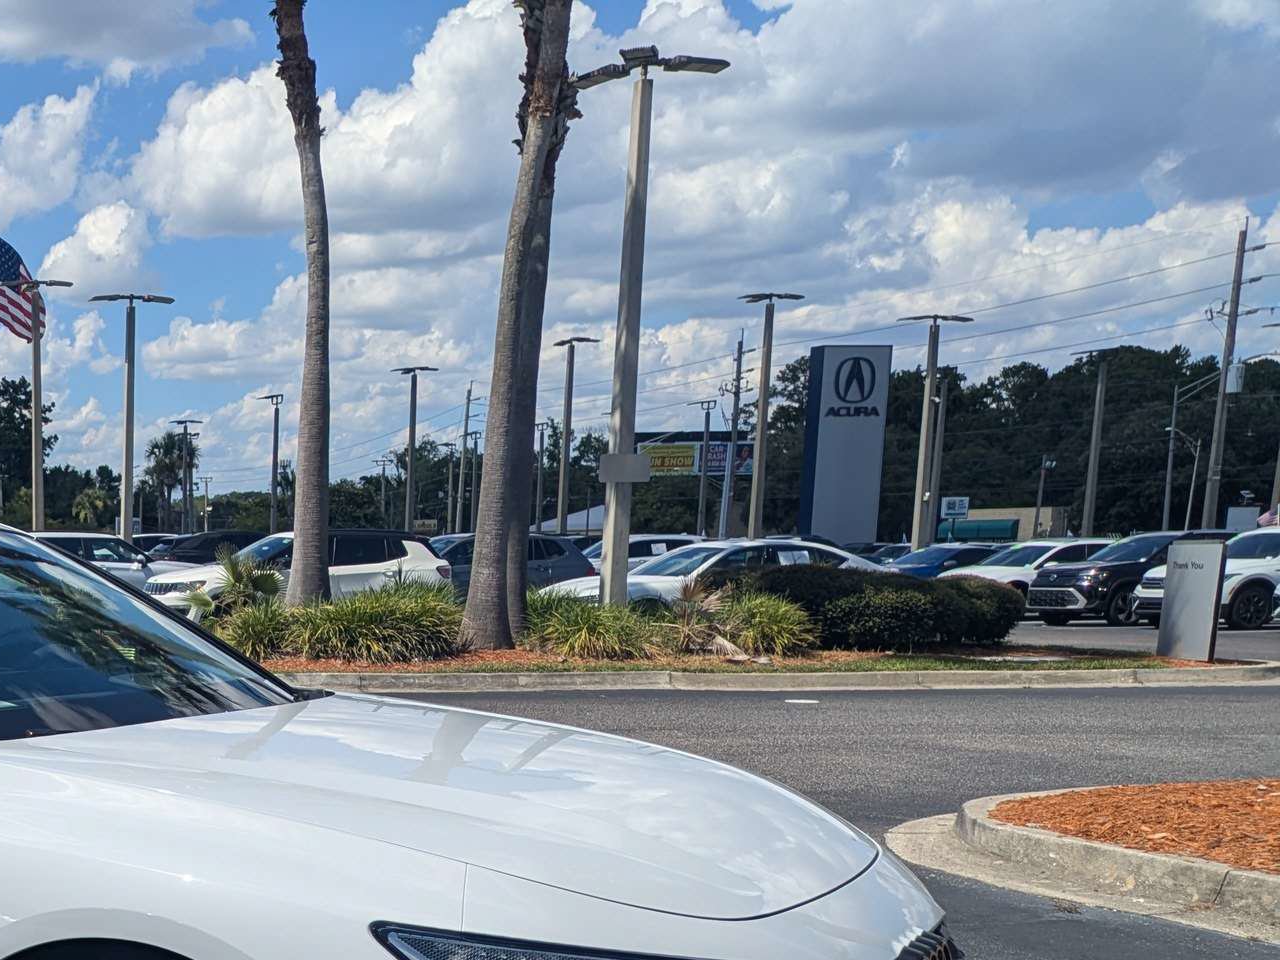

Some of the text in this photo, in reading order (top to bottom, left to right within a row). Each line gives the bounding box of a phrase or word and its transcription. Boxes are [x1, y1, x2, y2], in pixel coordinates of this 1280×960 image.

[824, 406, 880, 417] ACURA
[664, 456, 694, 466] SHOW
[1173, 561, 1204, 570] Thank You
